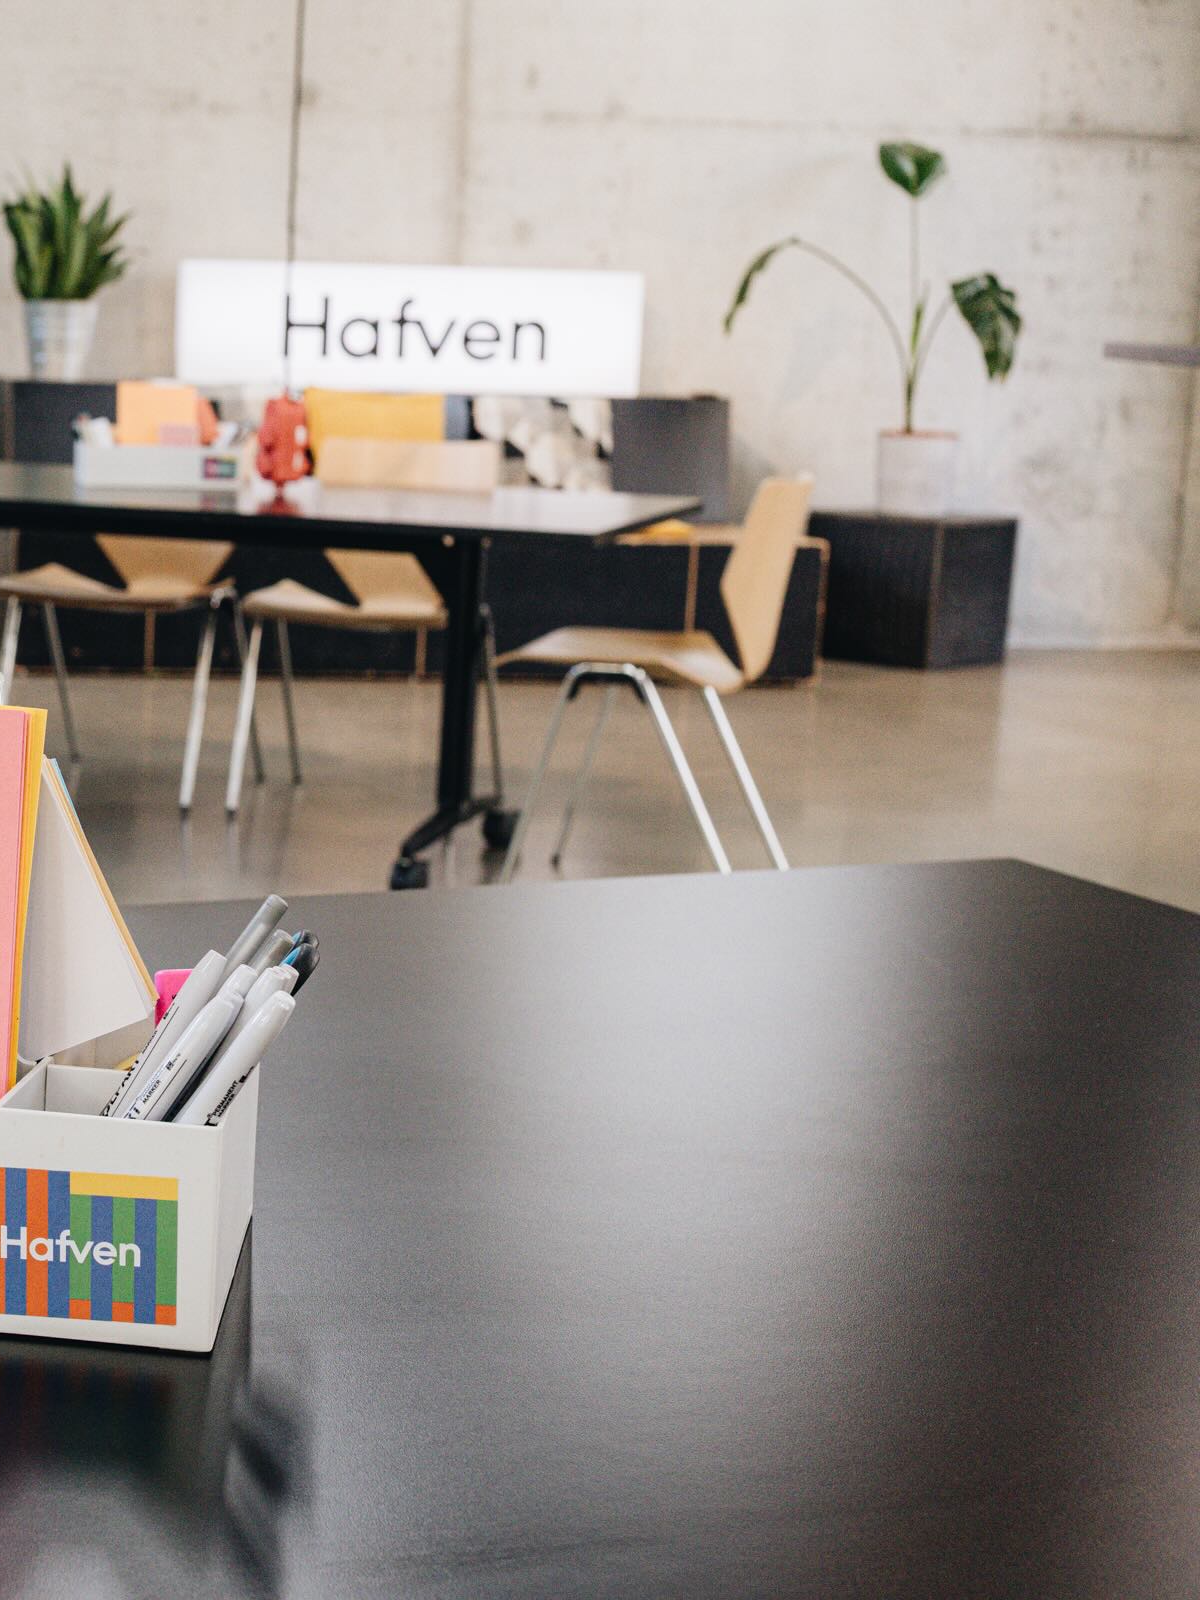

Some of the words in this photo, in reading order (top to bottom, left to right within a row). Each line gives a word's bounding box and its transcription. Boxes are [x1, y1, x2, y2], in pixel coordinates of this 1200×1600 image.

[284, 294, 546, 361] Hafven
[143, 1079, 161, 1105] MARKER
[212, 1080, 238, 1116] PERMANENT
[0, 1225, 141, 1267] Hafven
